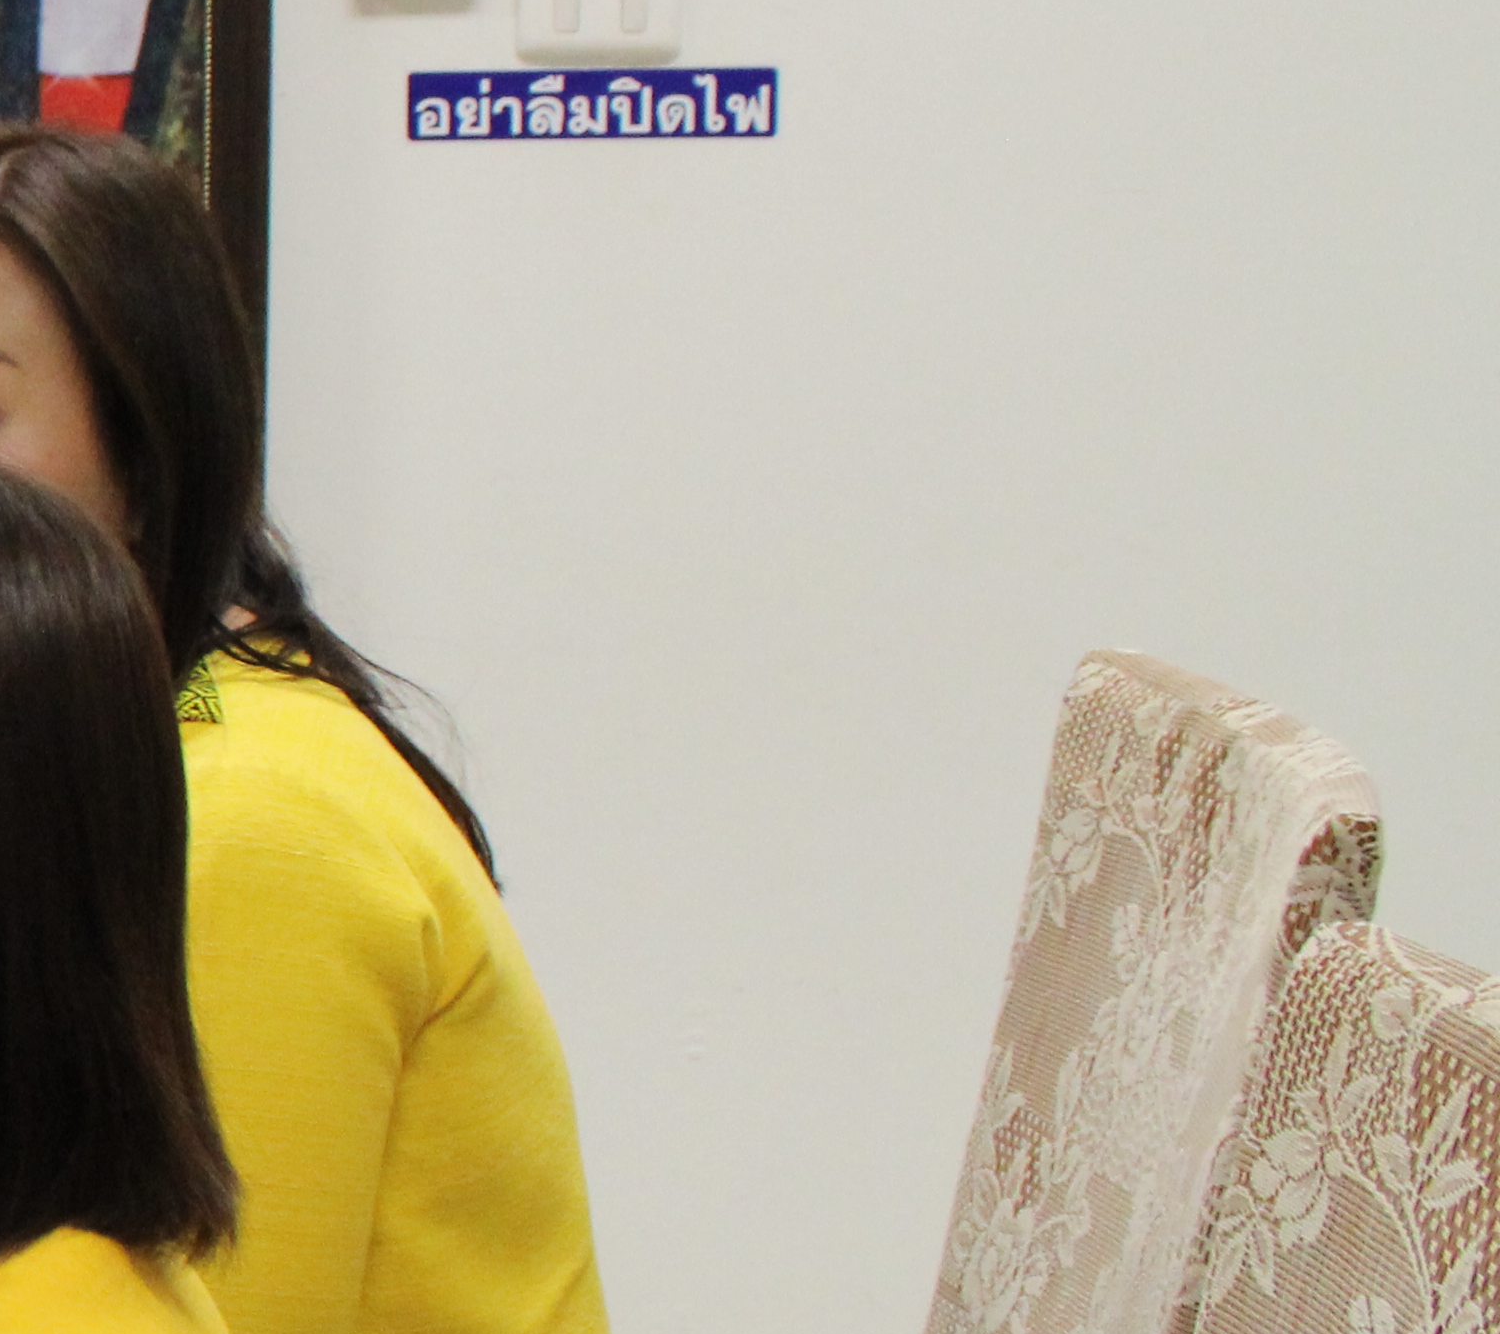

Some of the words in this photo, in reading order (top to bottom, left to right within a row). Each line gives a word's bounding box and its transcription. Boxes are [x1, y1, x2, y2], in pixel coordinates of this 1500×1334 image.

[414, 73, 771, 137] อย่าลืมปิดไฟ
